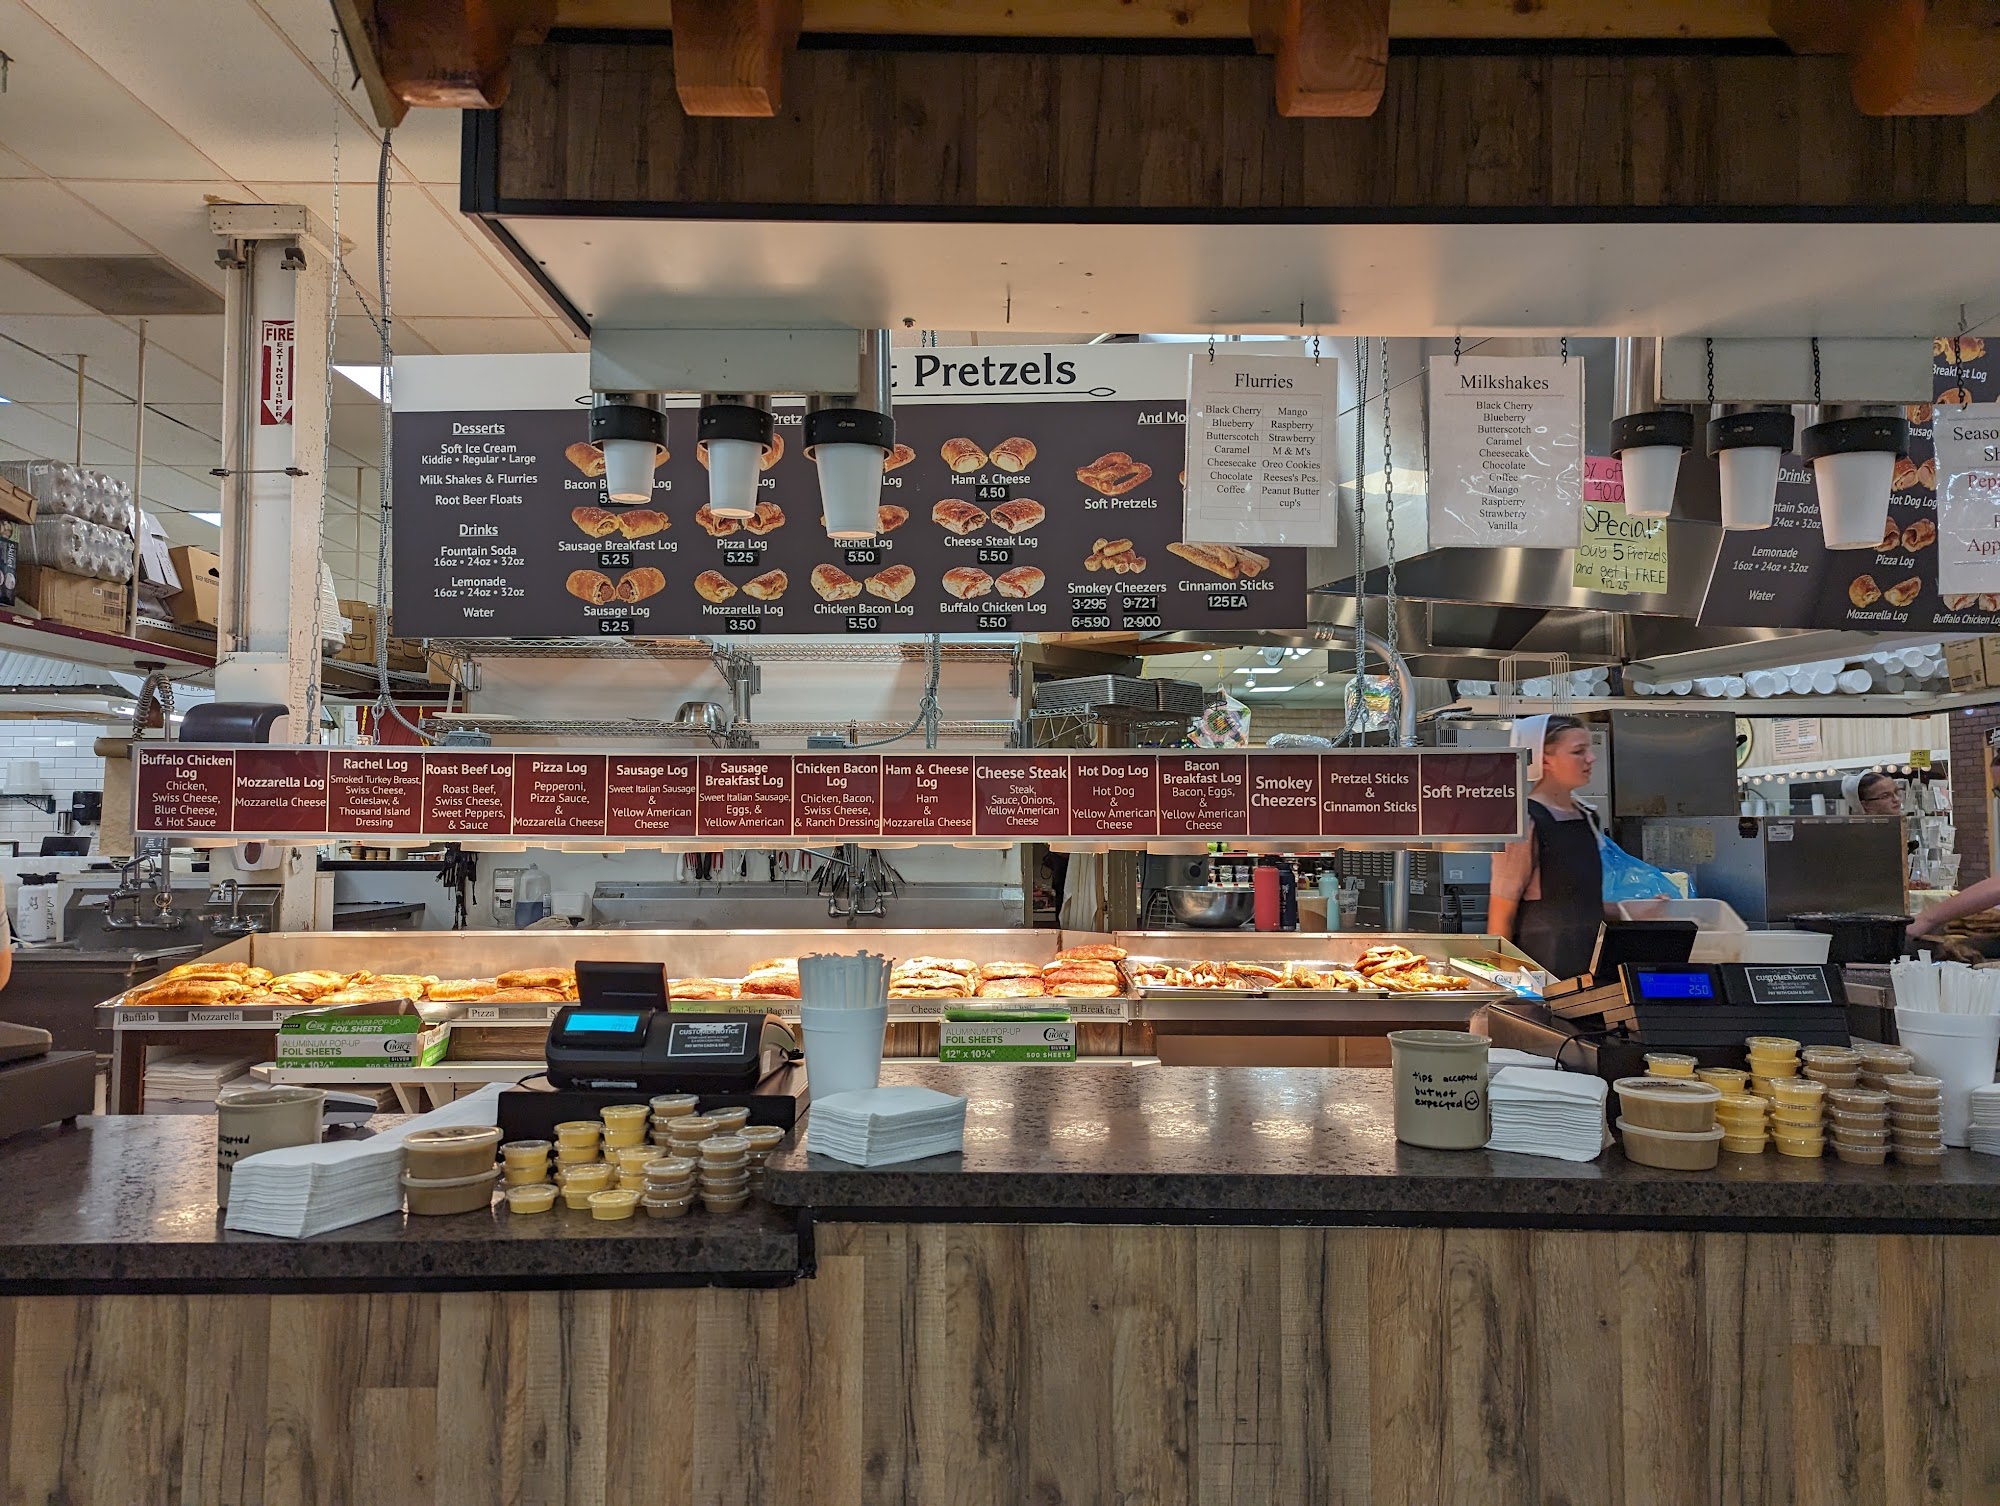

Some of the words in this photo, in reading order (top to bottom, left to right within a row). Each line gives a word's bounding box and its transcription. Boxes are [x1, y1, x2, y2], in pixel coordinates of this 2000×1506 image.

[266, 328, 294, 340] FIRE
[915, 353, 1077, 387] Pretzels
[1235, 373, 1293, 388] Flurries
[1461, 375, 1549, 389] Milkshakes
[1206, 406, 1231, 414] Black
[1232, 406, 1262, 416] Cherry
[1278, 408, 1308, 417] Mango
[453, 423, 505, 434] Desserts
[1212, 419, 1254, 429] Blueberry
[1271, 420, 1314, 431] Raspberry
[1206, 432, 1259, 441] Butterscotch
[1268, 433, 1315, 444] Strawberry
[441, 443, 461, 453] Soft
[464, 444, 479, 453] Ice
[483, 443, 516, 453] Cream
[1479, 449, 1529, 457] Cheesecake
[422, 455, 452, 464] Kiddie
[463, 455, 501, 465] Regular
[509, 454, 536, 465] Large
[1207, 458, 1256, 468] Cheesecake
[1262, 460, 1283, 468] Oreo
[1286, 460, 1320, 469] Cookies
[420, 475, 443, 484] Milk
[446, 474, 482, 484] Shakes
[486, 474, 494, 484] &
[498, 474, 537, 484] Flurries
[952, 475, 976, 484] Ham
[980, 475, 988, 484] &
[992, 474, 1030, 483] Cheese
[1210, 472, 1252, 480] Chocolate
[1778, 468, 1811, 481] Drinks
[980, 488, 1005, 498] 4.50
[436, 495, 459, 505] Root
[462, 495, 486, 504] Beer
[490, 494, 522, 504] Floats
[1085, 498, 1108, 508] Soft
[1112, 498, 1157, 508] Pretzels
[459, 524, 498, 535] Drinks
[1488, 522, 1518, 530] Vanilla
[558, 541, 602, 552] Sausage
[605, 541, 655, 550] Breakfast
[659, 541, 677, 552] Log
[717, 540, 745, 549] Pizza
[749, 539, 767, 551] Log
[944, 537, 982, 546] Cheese
[986, 536, 1015, 546] Steak
[1018, 536, 1037, 548] Log
[441, 546, 487, 556] Fountain
[490, 546, 516, 556] Soda
[980, 551, 1008, 561] 5.50
[1580, 545, 1606, 558] buy
[1613, 543, 1623, 560] 5
[1628, 546, 1666, 563] Pretzels
[1752, 546, 1798, 558] Lemonade
[434, 558, 457, 566] 16oz
[468, 558, 490, 566] 24oz
[501, 557, 524, 566] 32oz
[602, 554, 629, 565] 5.25
[727, 552, 753, 562] 5.25
[1876, 555, 1896, 565] Pizza
[1899, 556, 1914, 568] Log
[1576, 563, 1593, 574] and
[1601, 566, 1619, 578] get
[1625, 566, 1628, 579] 1
[1636, 569, 1666, 583] FREE
[451, 577, 506, 587] Lemonade
[1178, 581, 1236, 591] Cinnamon
[1240, 580, 1274, 590] Sticks
[1068, 583, 1112, 595] Smokey
[1115, 582, 1166, 592] Cheezers
[463, 608, 494, 617] Water
[584, 607, 627, 617] Sausage
[631, 606, 649, 618] Log
[703, 605, 760, 614] Mozzarella
[765, 604, 783, 616] Log
[814, 604, 855, 614] Chicken
[859, 604, 891, 614] Bacon
[895, 604, 913, 615] Log
[940, 603, 978, 612] Buffalo
[982, 603, 1023, 612] Chicken
[1027, 602, 1046, 614] Log
[1847, 610, 1890, 620] Mozzarella
[1892, 612, 1908, 622] Log
[730, 620, 756, 630] 3.50
[849, 618, 877, 628] 5.50
[980, 617, 1006, 627] 5.50
[141, 754, 184, 765] Buffalo
[187, 754, 232, 765] Chicken
[344, 759, 384, 769] Rachel
[387, 760, 408, 772] Log
[426, 764, 458, 774] Roast
[462, 764, 487, 774] Beef
[491, 765, 511, 777] Log
[533, 763, 562, 773] Pizza
[566, 763, 587, 775] Log
[617, 765, 663, 777] Sausage
[667, 766, 688, 777] Log
[721, 763, 768, 775] Sausage
[796, 764, 840, 774] Chicken
[844, 764, 877, 774] Bacon
[886, 764, 912, 775] Ham
[915, 765, 924, 775] &
[928, 764, 968, 774] Cheese
[1185, 761, 1219, 771] Bacon
[176, 768, 197, 780] Log
[976, 766, 1024, 779] Cheese
[1029, 766, 1067, 779] Steak
[1078, 766, 1099, 776] Hot
[1102, 766, 1125, 778] Dog
[1128, 766, 1148, 778] Log
[237, 777, 300, 788] Mozzarella
[304, 778, 324, 790] Log
[706, 776, 759, 786] Breakfast
[762, 776, 783, 788] Log
[827, 776, 847, 788] Log
[917, 777, 937, 789] Log
[1164, 773, 1217, 784] Breakfast
[1221, 773, 1241, 786] Log
[1256, 776, 1312, 792] Smokey
[1331, 773, 1371, 784] Pretzel
[1375, 774, 1408, 784] Sticks
[535, 782, 586, 793] Pepperoni,
[1423, 785, 1452, 798] Soft
[1456, 785, 1515, 798] Pretzels
[235, 798, 288, 807] Mozzarella
[291, 798, 326, 807] Cheese
[1251, 794, 1316, 807] Cheezers
[1324, 801, 1380, 812] Cinnamon
[1384, 802, 1417, 812] Sticks
[356, 818, 393, 828] Dressing
[122, 1013, 154, 1022] Buffalo
[191, 1013, 239, 1021] Mozzarella
[472, 1009, 495, 1018] Pizza
[1413, 1072, 1432, 1082] tips
[1443, 1073, 1477, 1083] accepted
[1415, 1086, 1434, 1096] but
[1415, 1099, 1462, 1110] expected
